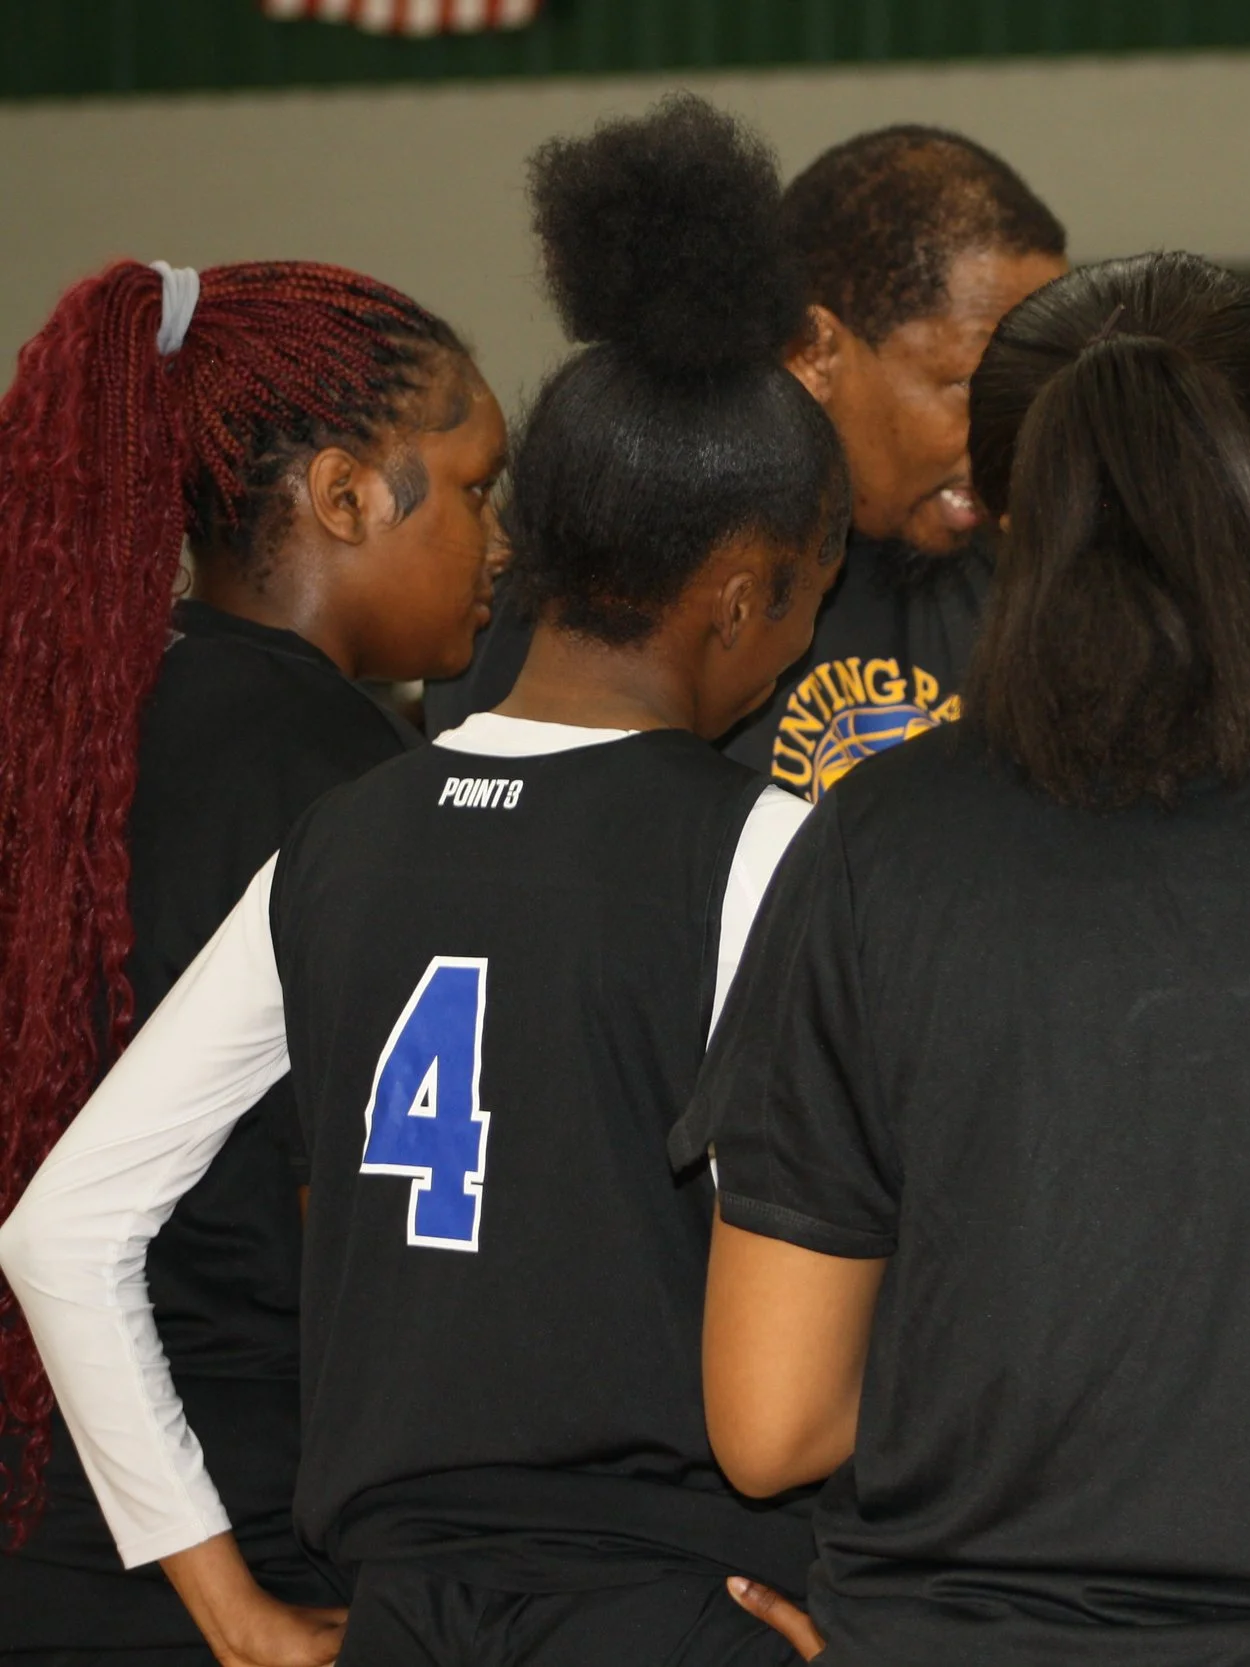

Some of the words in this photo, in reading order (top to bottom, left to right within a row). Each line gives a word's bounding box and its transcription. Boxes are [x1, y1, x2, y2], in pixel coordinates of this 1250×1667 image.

[438, 777, 524, 809] POINT3
[771, 656, 908, 803] UNTING
[359, 955, 492, 1253] 4
